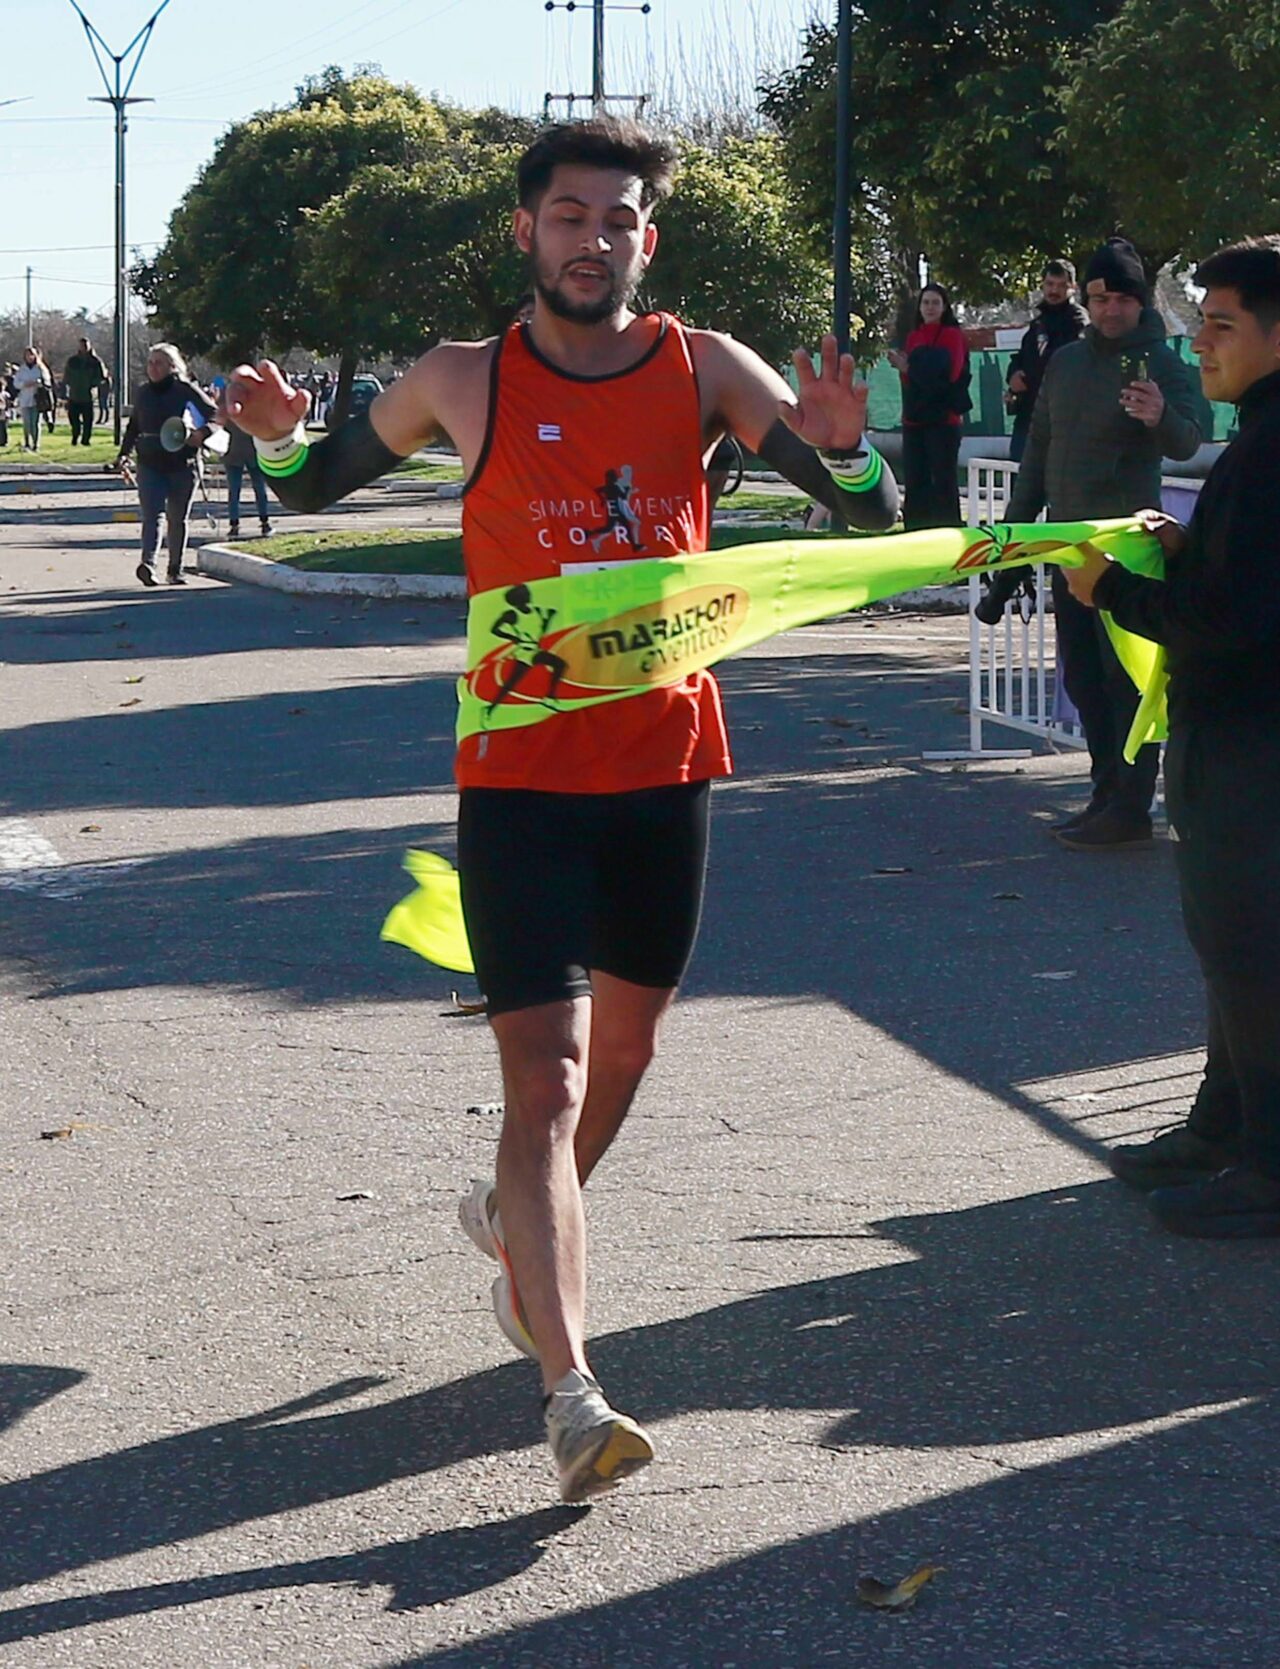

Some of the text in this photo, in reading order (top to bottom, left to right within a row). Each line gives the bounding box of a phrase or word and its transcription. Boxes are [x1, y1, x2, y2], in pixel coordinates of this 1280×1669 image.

[528, 494, 690, 521] SIMPLEMENT
[538, 524, 675, 548] CORR
[588, 593, 736, 659] MARATHON
[639, 619, 728, 673] eventos
